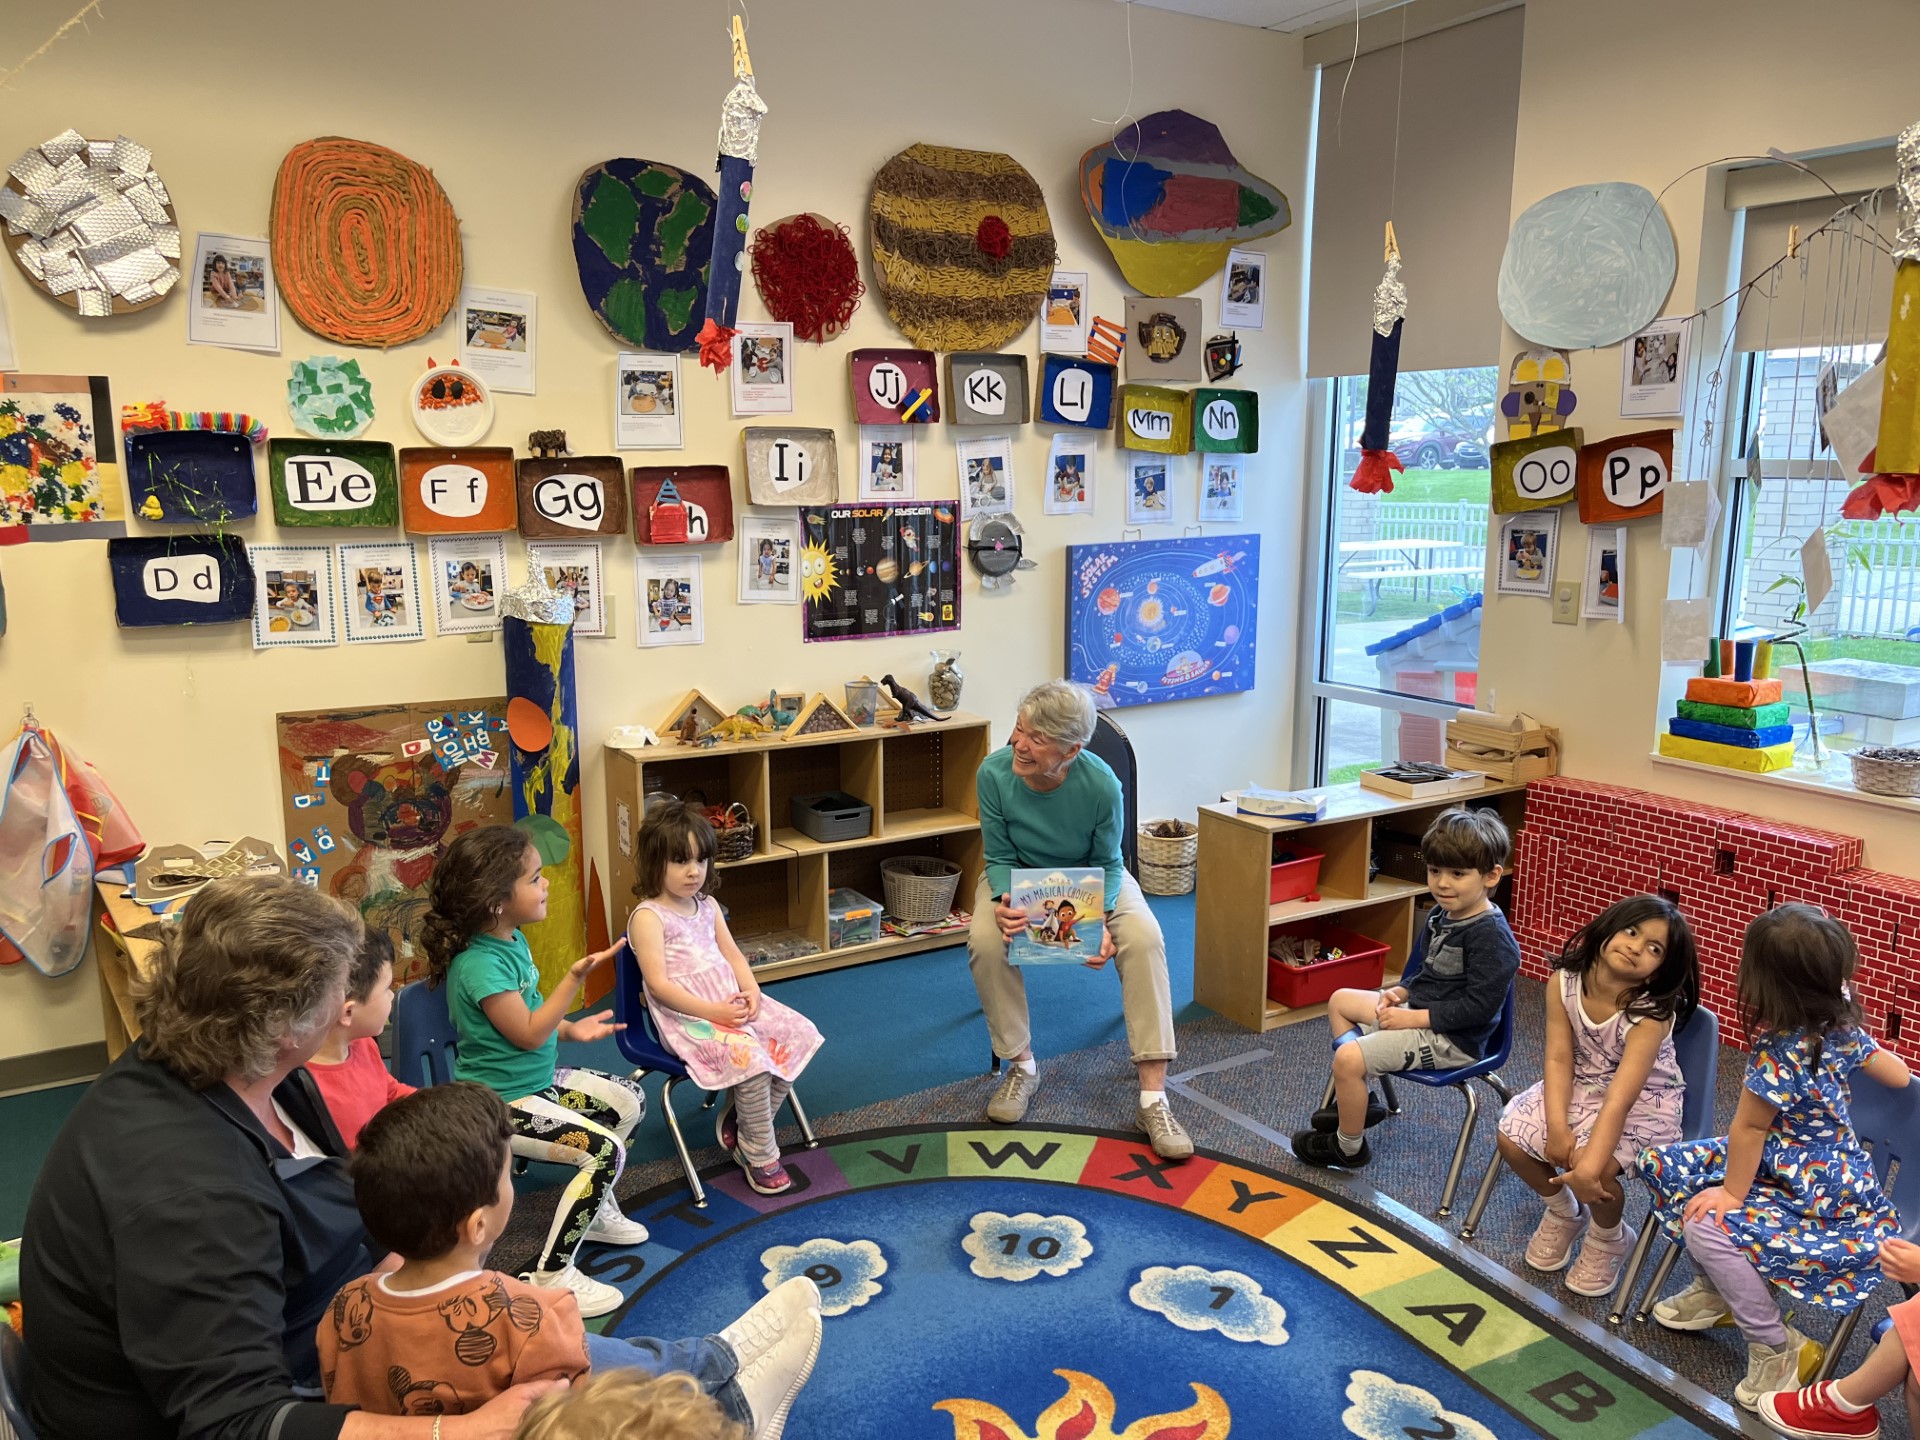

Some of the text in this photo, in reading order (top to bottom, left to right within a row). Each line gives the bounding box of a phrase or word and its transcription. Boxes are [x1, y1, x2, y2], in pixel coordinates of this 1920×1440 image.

[875, 369, 901, 404] Jj
[968, 376, 1003, 404] Kk
[1132, 409, 1171, 433] Mm
[1208, 405, 1239, 430] Nn
[288, 461, 373, 504] Ee
[534, 478, 602, 522] Gg
[831, 507, 932, 519] OUR SOLAR SYSTEM
[1020, 886, 1096, 906] MY MAGICAL CHOICES
[866, 1143, 922, 1175] V
[967, 1140, 1063, 1170] W
[1111, 1153, 1177, 1190] X
[1227, 1179, 1287, 1214] Y
[649, 1199, 715, 1229] T
[997, 1232, 1062, 1261] 10
[1307, 1226, 1398, 1270] Z
[577, 1249, 646, 1283] S
[804, 1263, 843, 1289] 9
[1208, 1286, 1236, 1311] 1
[1403, 1303, 1488, 1347] A
[1526, 1371, 1617, 1423] B
